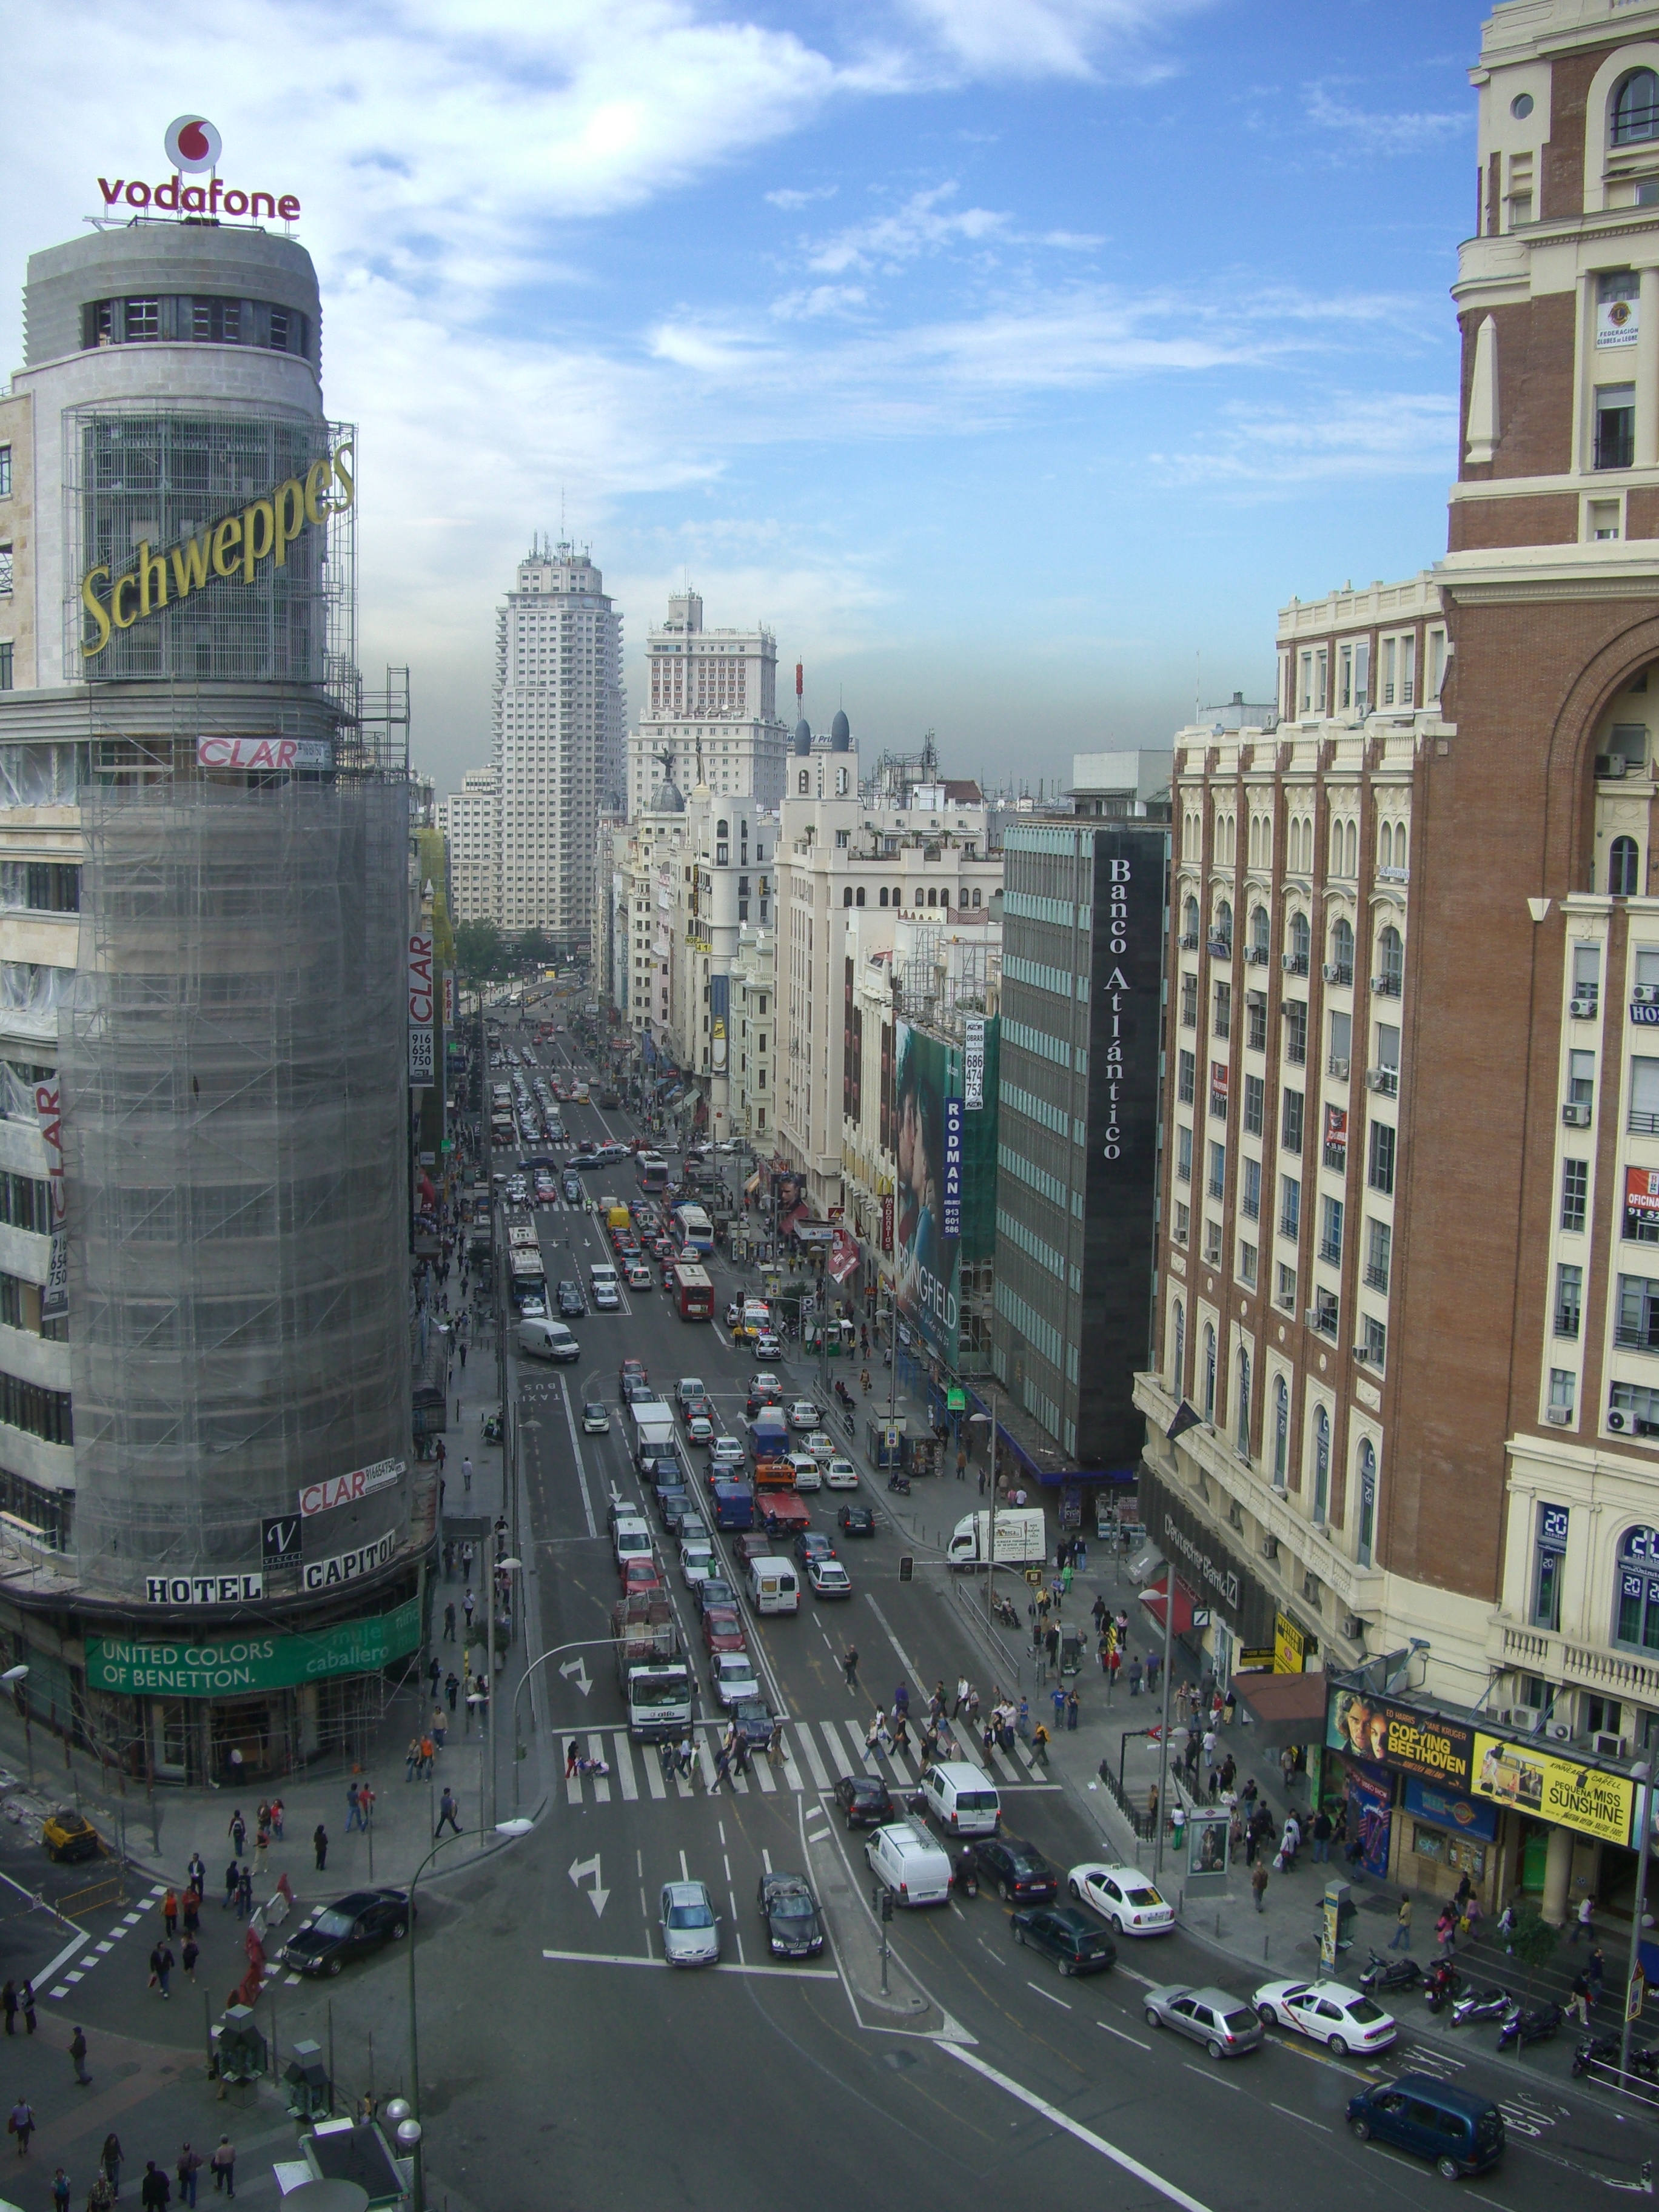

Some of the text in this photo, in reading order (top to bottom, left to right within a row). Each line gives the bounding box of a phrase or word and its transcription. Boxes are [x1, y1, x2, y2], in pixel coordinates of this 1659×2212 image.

[98, 176, 301, 221] vodafone
[81, 440, 355, 657] Schweppes
[198, 739, 298, 768] CLAR
[409, 936, 432, 1022] CLAR
[1103, 859, 1131, 1160] Banco Atlántico
[1632, 1006, 1659, 1022] HO
[412, 1034, 431, 1044] 916
[412, 1045, 431, 1055] 654
[412, 1056, 431, 1066] 750
[967, 1054, 983, 1068] 686
[967, 1069, 982, 1082] 474
[967, 1083, 981, 1096] 753
[36, 1087, 66, 1219] CLAR
[947, 1102, 960, 1194] RODMAN
[1628, 1207, 1642, 1217] 91
[885, 1196, 893, 1250] McDonald's
[49, 1269, 66, 1287] 750
[803, 1298, 813, 1310] P
[524, 1382, 556, 1391] BUS
[523, 1393, 561, 1402] TAXI
[301, 1471, 366, 1515] CLAR
[1545, 1510, 1567, 1535] 20
[1544, 1532, 1566, 1540] minutos
[264, 1553, 302, 1564] VINCCI
[307, 1533, 395, 1589] CAPITOL
[1165, 1513, 1204, 1570] Deutsche
[1203, 1555, 1227, 1597] Bank
[1543, 1558, 1553, 1567] 20
[147, 1577, 261, 1603] HOTEL
[1624, 1576, 1641, 1594] 20
[102, 1641, 273, 1666] UNITED COLORS
[306, 1645, 389, 1673] caballero
[103, 1665, 256, 1689] OF BENETTON.
[1386, 1709, 1416, 1725] ED HARRIS
[1389, 1721, 1451, 1755] COPYING
[1441, 1724, 1467, 1741] KRUGER
[1387, 1736, 1466, 1776] BEETHOVEN
[1590, 1774, 1621, 1790] CARELL
[1549, 1787, 1624, 1826] SUNSHINE
[1594, 1788, 1621, 1808] MISS
